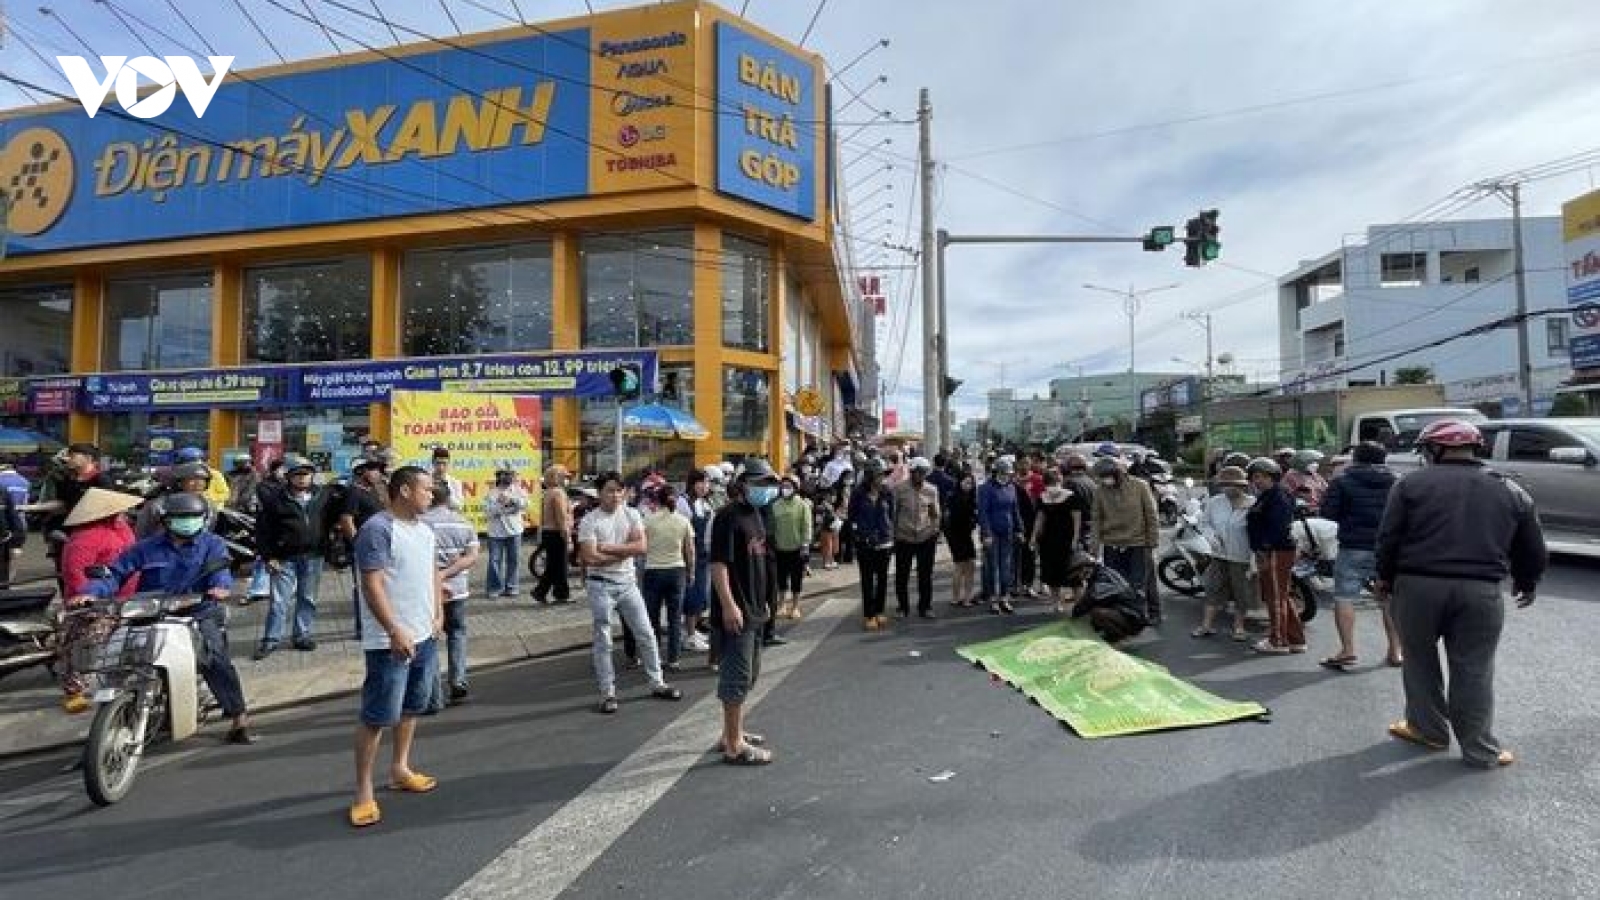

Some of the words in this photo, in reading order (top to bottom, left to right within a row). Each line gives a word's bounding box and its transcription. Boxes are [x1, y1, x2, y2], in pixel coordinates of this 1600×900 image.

[617, 59, 668, 80] AQUA
[739, 53, 799, 106] BÁN
[93, 131, 213, 203] Điện
[335, 80, 556, 171] XANH
[744, 107, 799, 152] TRẢ
[606, 153, 677, 172] TOSHIBA
[738, 149, 800, 192] GÓP
